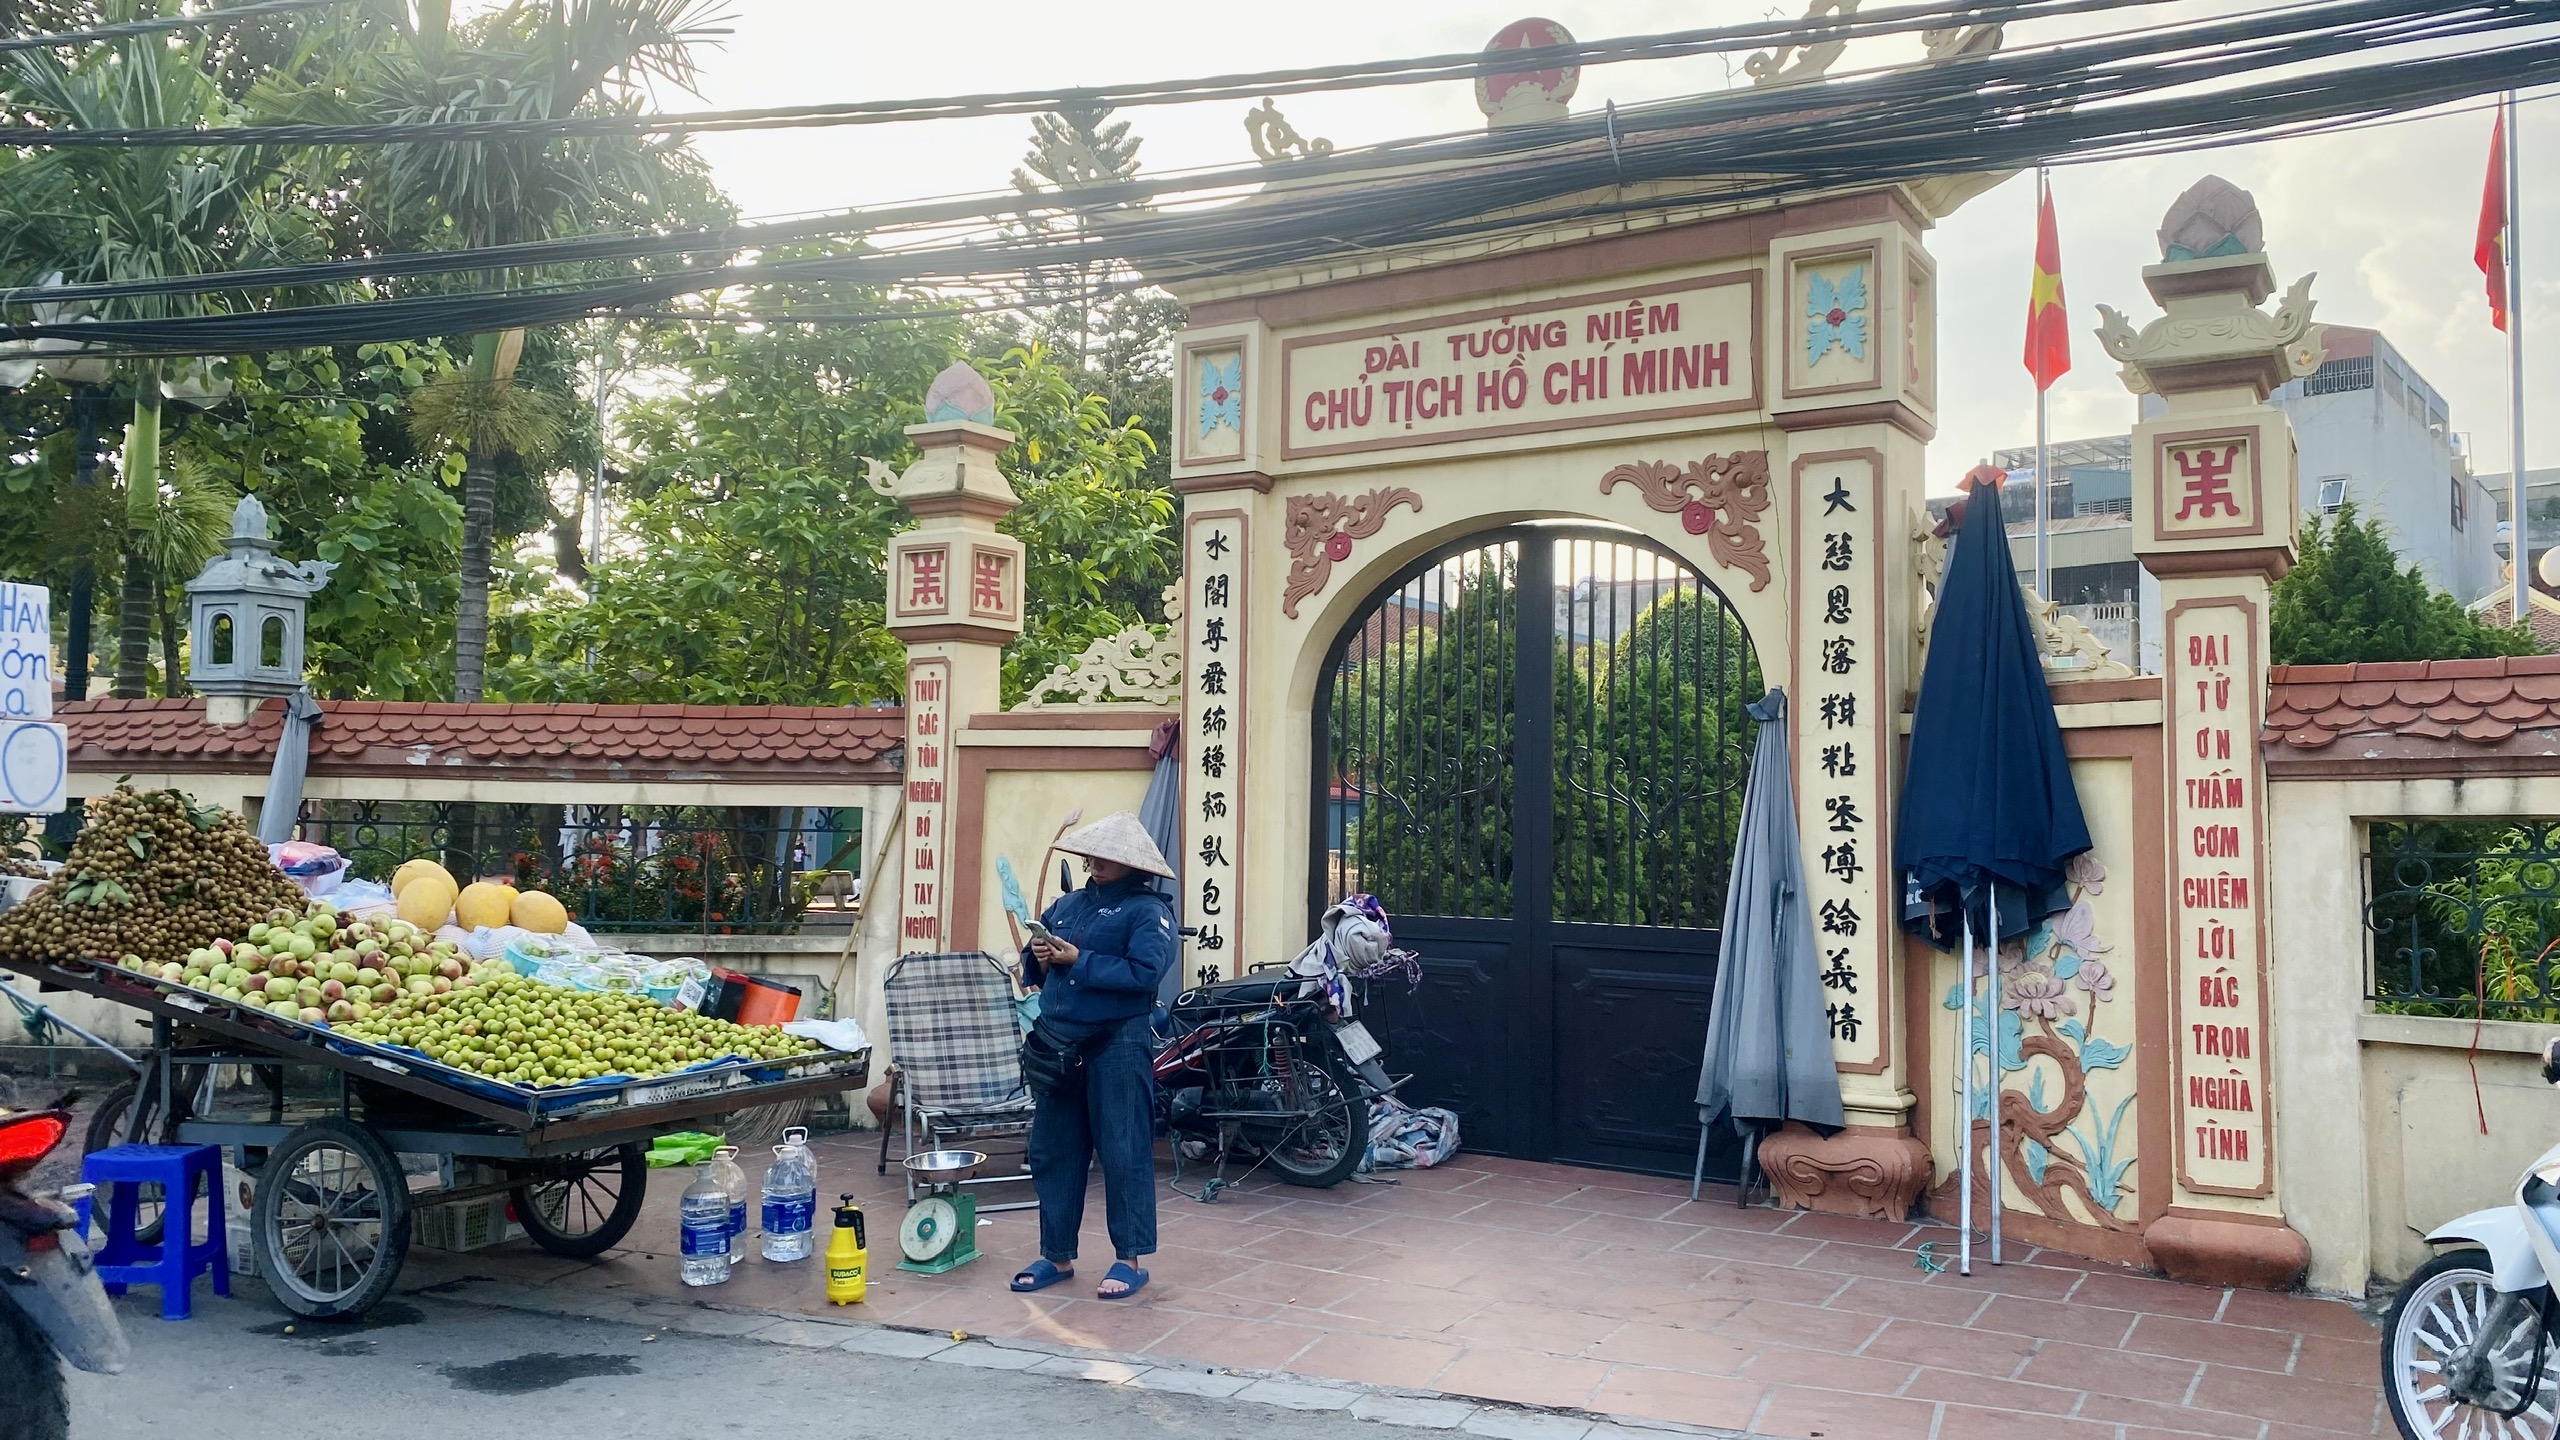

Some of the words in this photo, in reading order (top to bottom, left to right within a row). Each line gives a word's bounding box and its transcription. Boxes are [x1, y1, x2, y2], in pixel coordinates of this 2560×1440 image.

[1365, 334, 1419, 374] ĐÀI
[1447, 315, 1567, 361] TƯỞNG
[1587, 299, 1680, 344] NIỆM
[1305, 374, 1373, 431] CHỦ
[1383, 374, 1463, 429] TỊCH
[1477, 353, 1528, 412] HỒ
[1543, 342, 1616, 405] CHÍ
[1623, 341, 1728, 397] MINH
[2189, 634, 2229, 671] ĐẠI
[917, 741, 938, 768] TÔN
[2196, 727, 2230, 760] ƠN
[909, 777, 942, 803] NGHIÊM
[2186, 768, 2243, 808] THẤM
[915, 842, 934, 871] LÚA
[2193, 824, 2240, 858] CƠM
[914, 883, 934, 905] TAY
[2183, 870, 2249, 909] CHIÊM
[905, 910, 936, 939] NGƯỜI
[2198, 918, 2236, 960] LỜI
[2199, 966, 2239, 1008] BÁC
[2192, 1024, 2251, 1064] TRỌN
[2196, 1118, 2250, 1161] TÌNH
